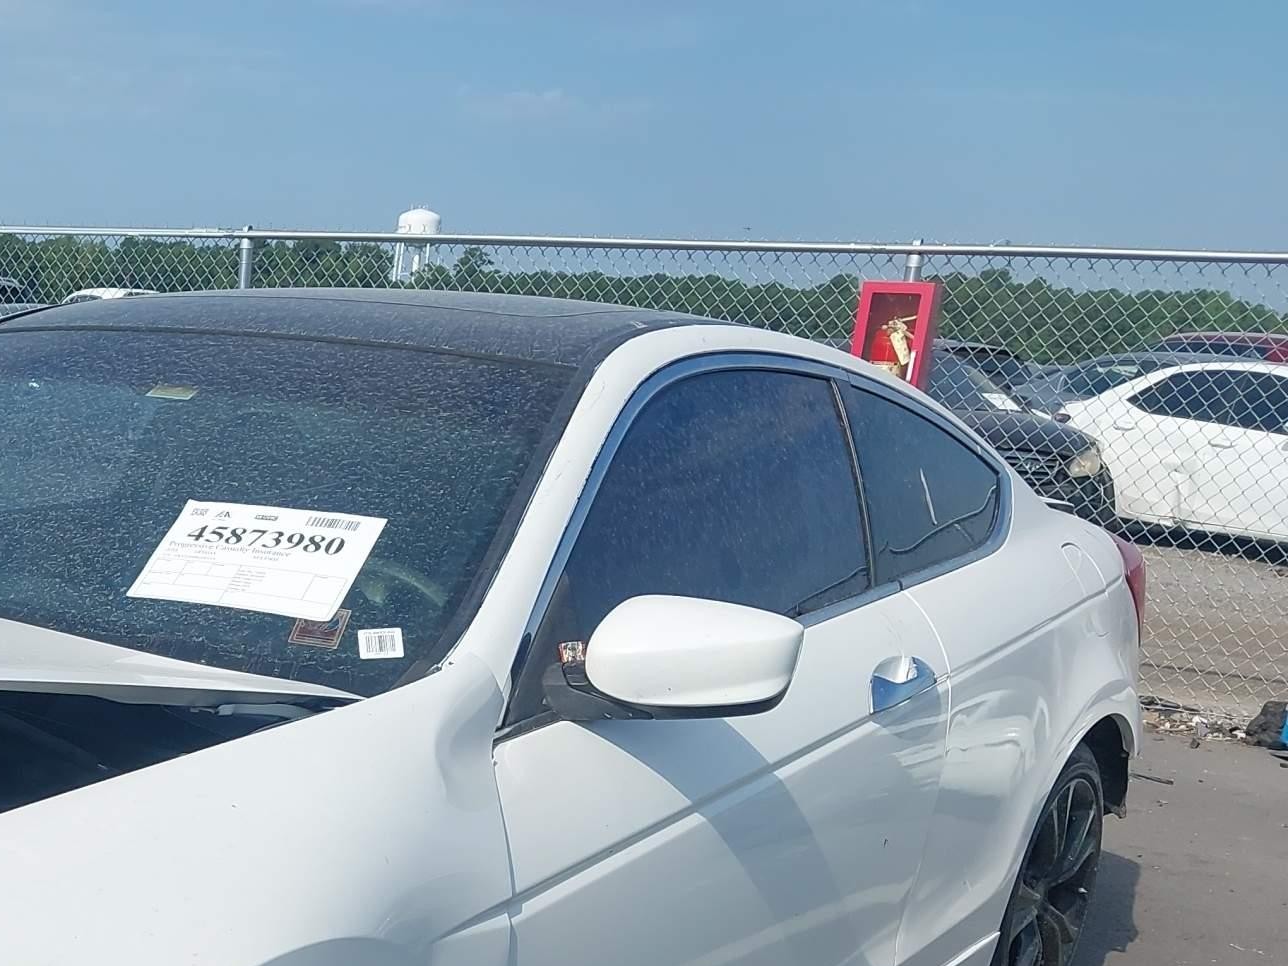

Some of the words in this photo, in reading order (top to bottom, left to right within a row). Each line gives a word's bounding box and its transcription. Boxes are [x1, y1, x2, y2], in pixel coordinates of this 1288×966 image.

[187, 525, 345, 556] 45873980
[215, 545, 250, 554] Casualty
[252, 547, 292, 557] Insurance
